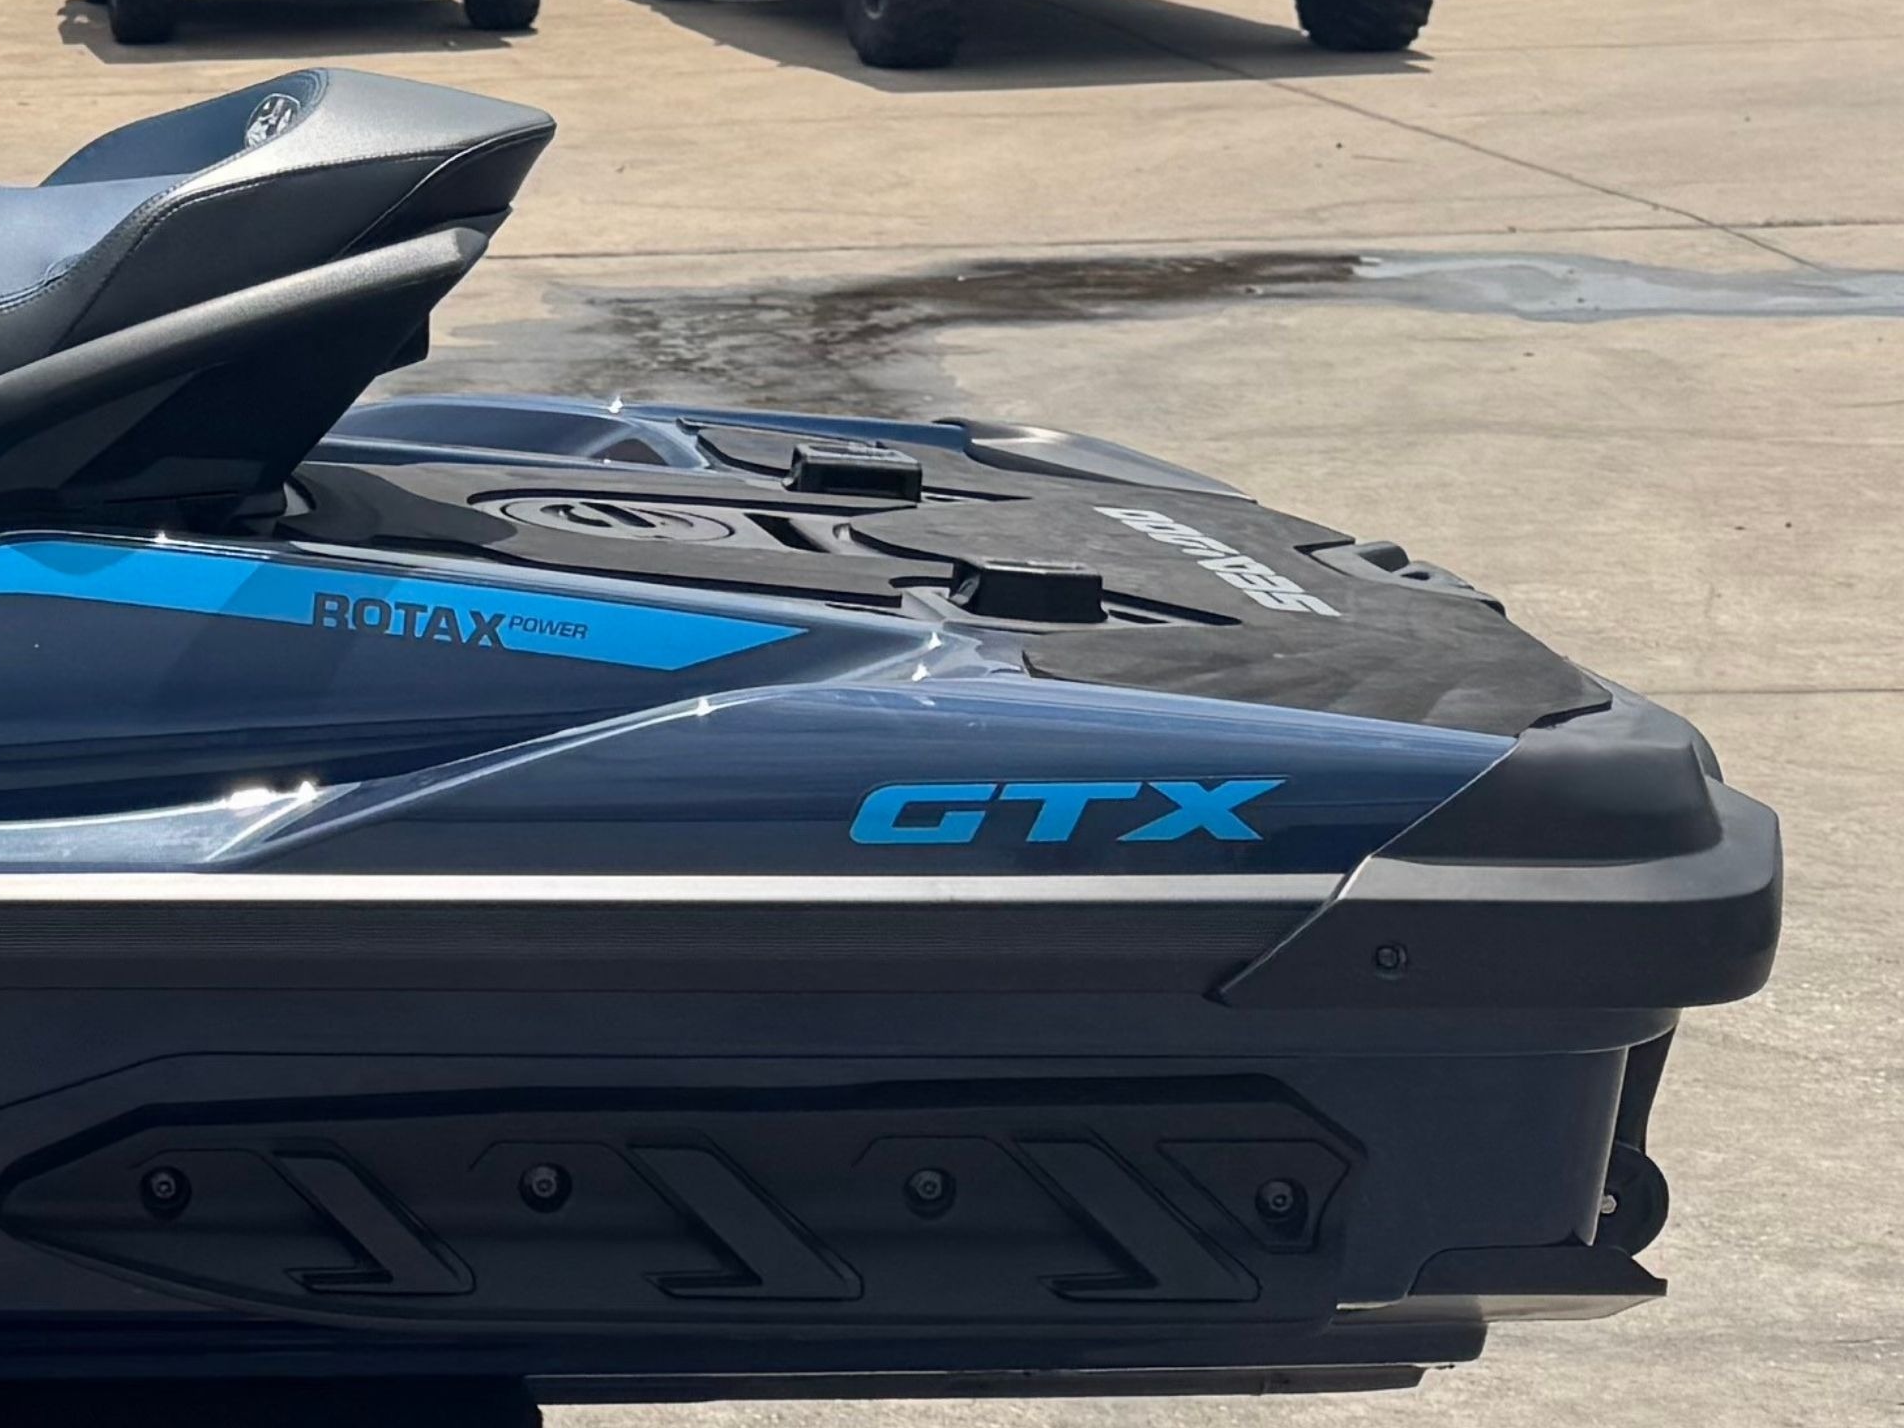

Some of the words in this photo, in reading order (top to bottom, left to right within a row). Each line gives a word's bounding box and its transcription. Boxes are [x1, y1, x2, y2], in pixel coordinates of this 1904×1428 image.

[312, 591, 507, 649] ROTAX
[508, 615, 589, 640] POWER
[849, 777, 1290, 845] GTX
